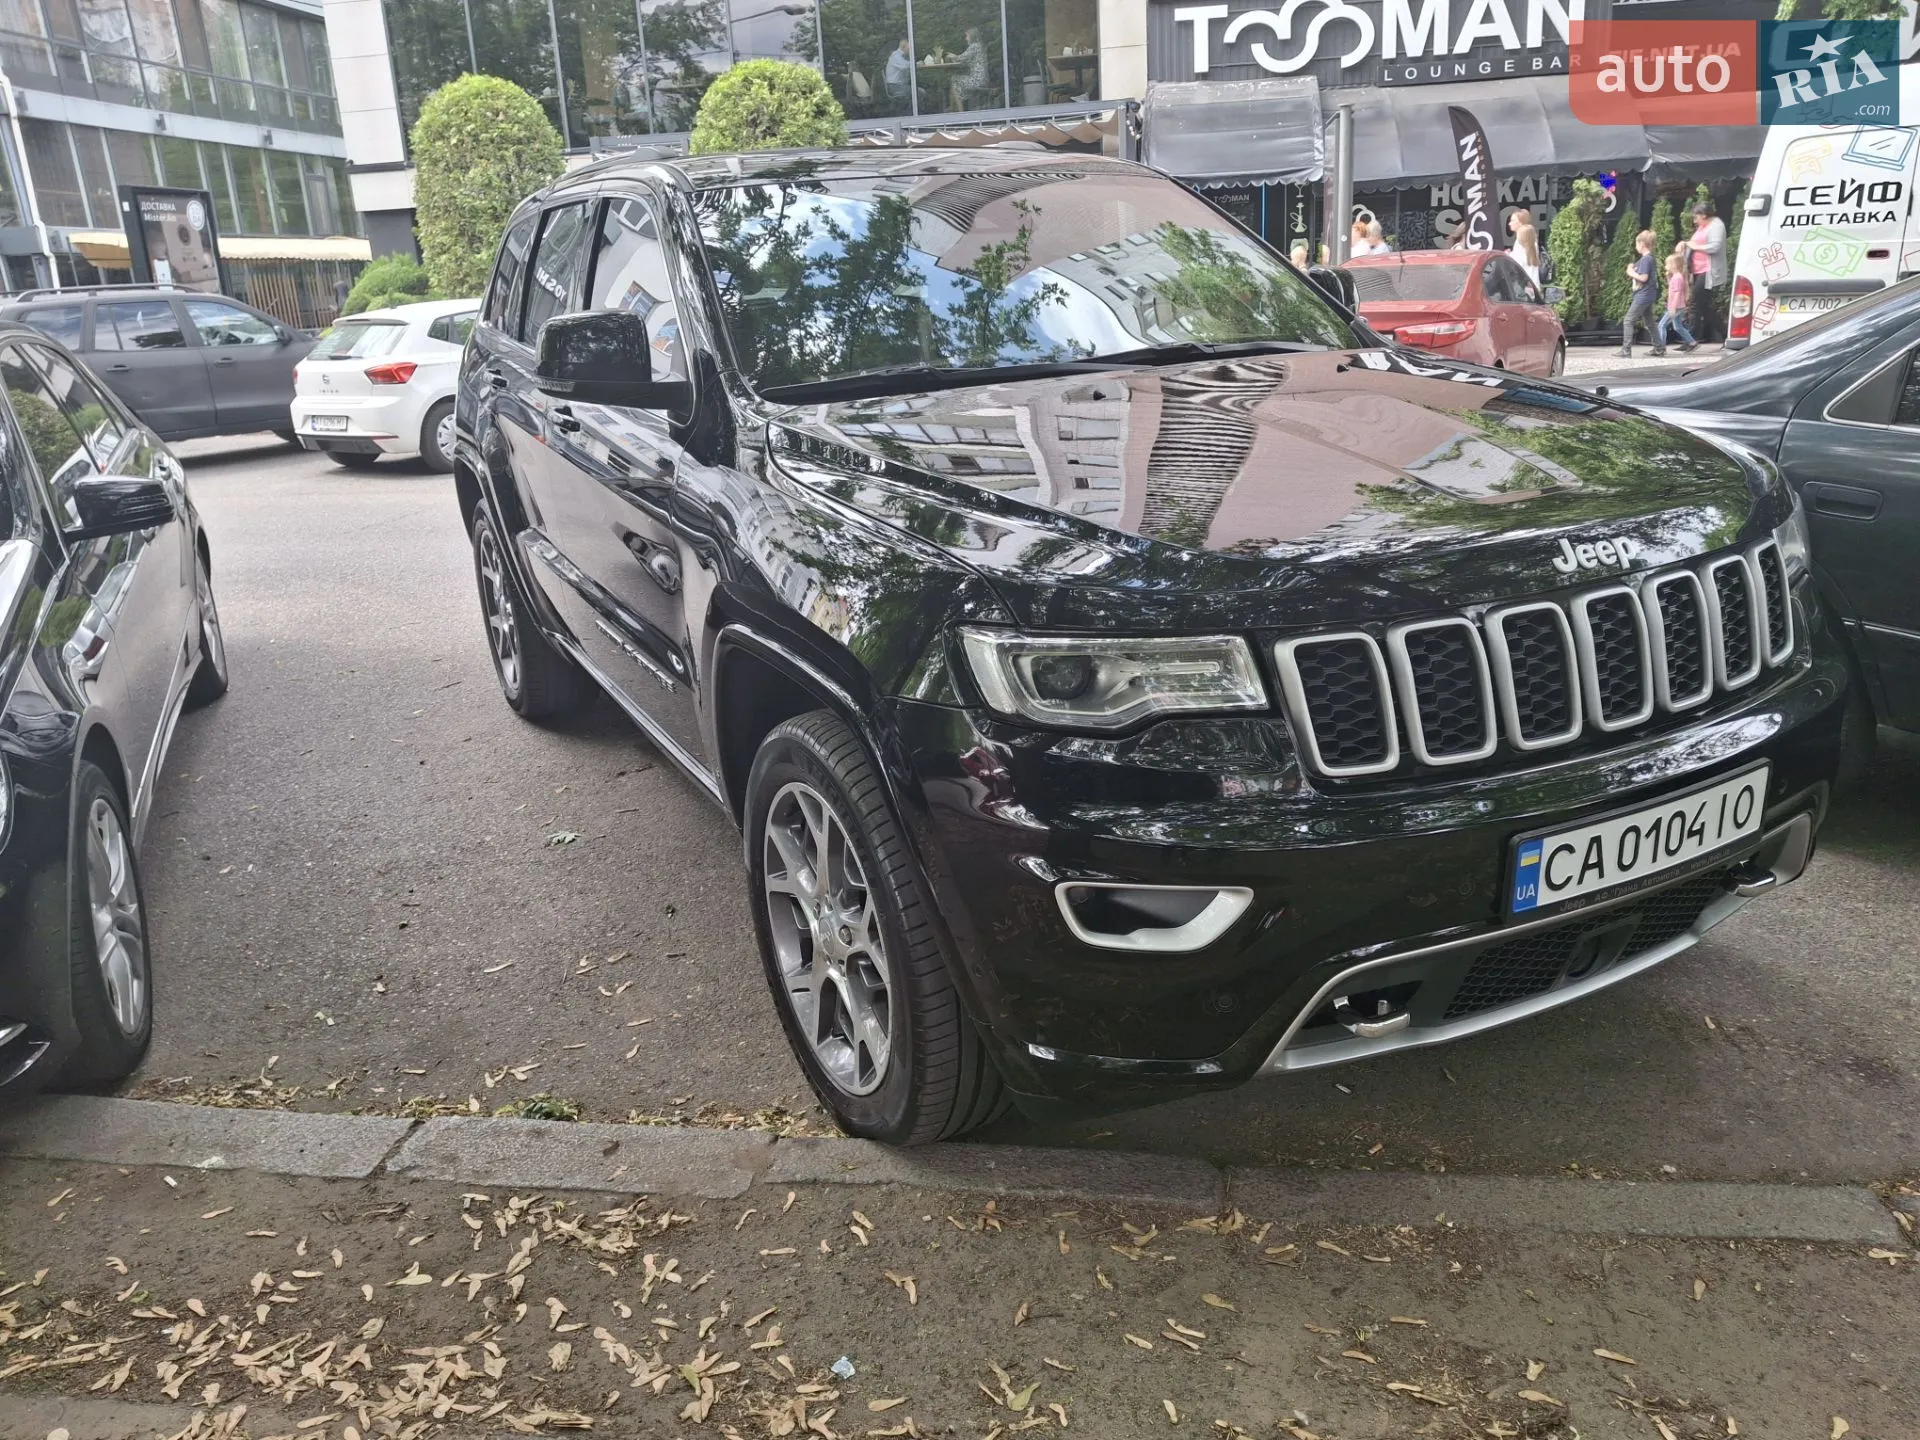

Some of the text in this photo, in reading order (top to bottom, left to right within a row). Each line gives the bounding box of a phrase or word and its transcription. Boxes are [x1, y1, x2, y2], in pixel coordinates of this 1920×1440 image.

[1384, 54, 1581, 82] LOUNGE BAR
[1430, 175, 1558, 207] HOKAH
[1783, 178, 1902, 209] СЕЙФ
[1780, 210, 1897, 229] ДОСТАВКА
[1788, 297, 1807, 311] CA
[1552, 536, 1637, 573] Jeep
[1544, 834, 1605, 892] CA
[1616, 800, 1709, 873] 0104
[1516, 885, 1536, 901] UA
